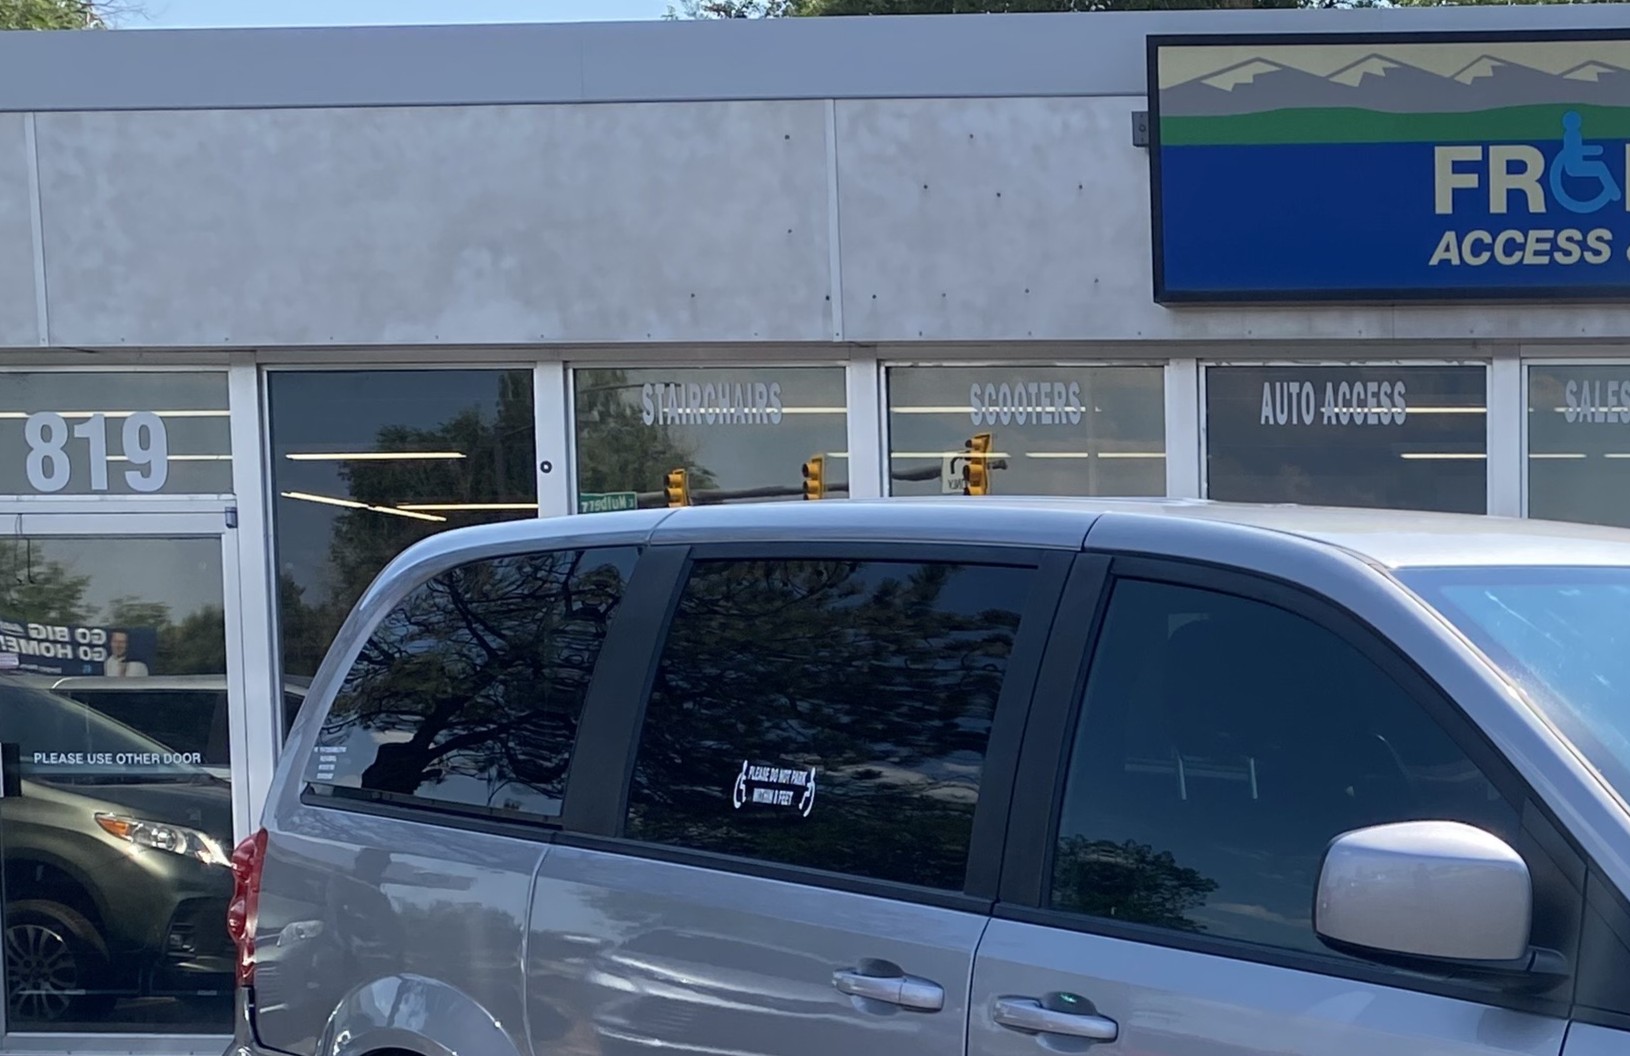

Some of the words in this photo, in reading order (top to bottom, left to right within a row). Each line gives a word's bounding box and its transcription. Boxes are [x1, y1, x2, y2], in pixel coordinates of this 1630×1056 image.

[1429, 228, 1613, 266] ACCESS
[641, 382, 783, 426] STAIRCHAIRS
[970, 381, 1081, 425] SCOOTERS
[1260, 381, 1315, 425] AUTO
[1323, 381, 1406, 425] ACCESS
[24, 410, 168, 493] 819
[34, 752, 84, 765] PLEASE
[87, 752, 113, 765] USE
[116, 752, 160, 765] OTHER
[163, 752, 201, 765] DOOR
